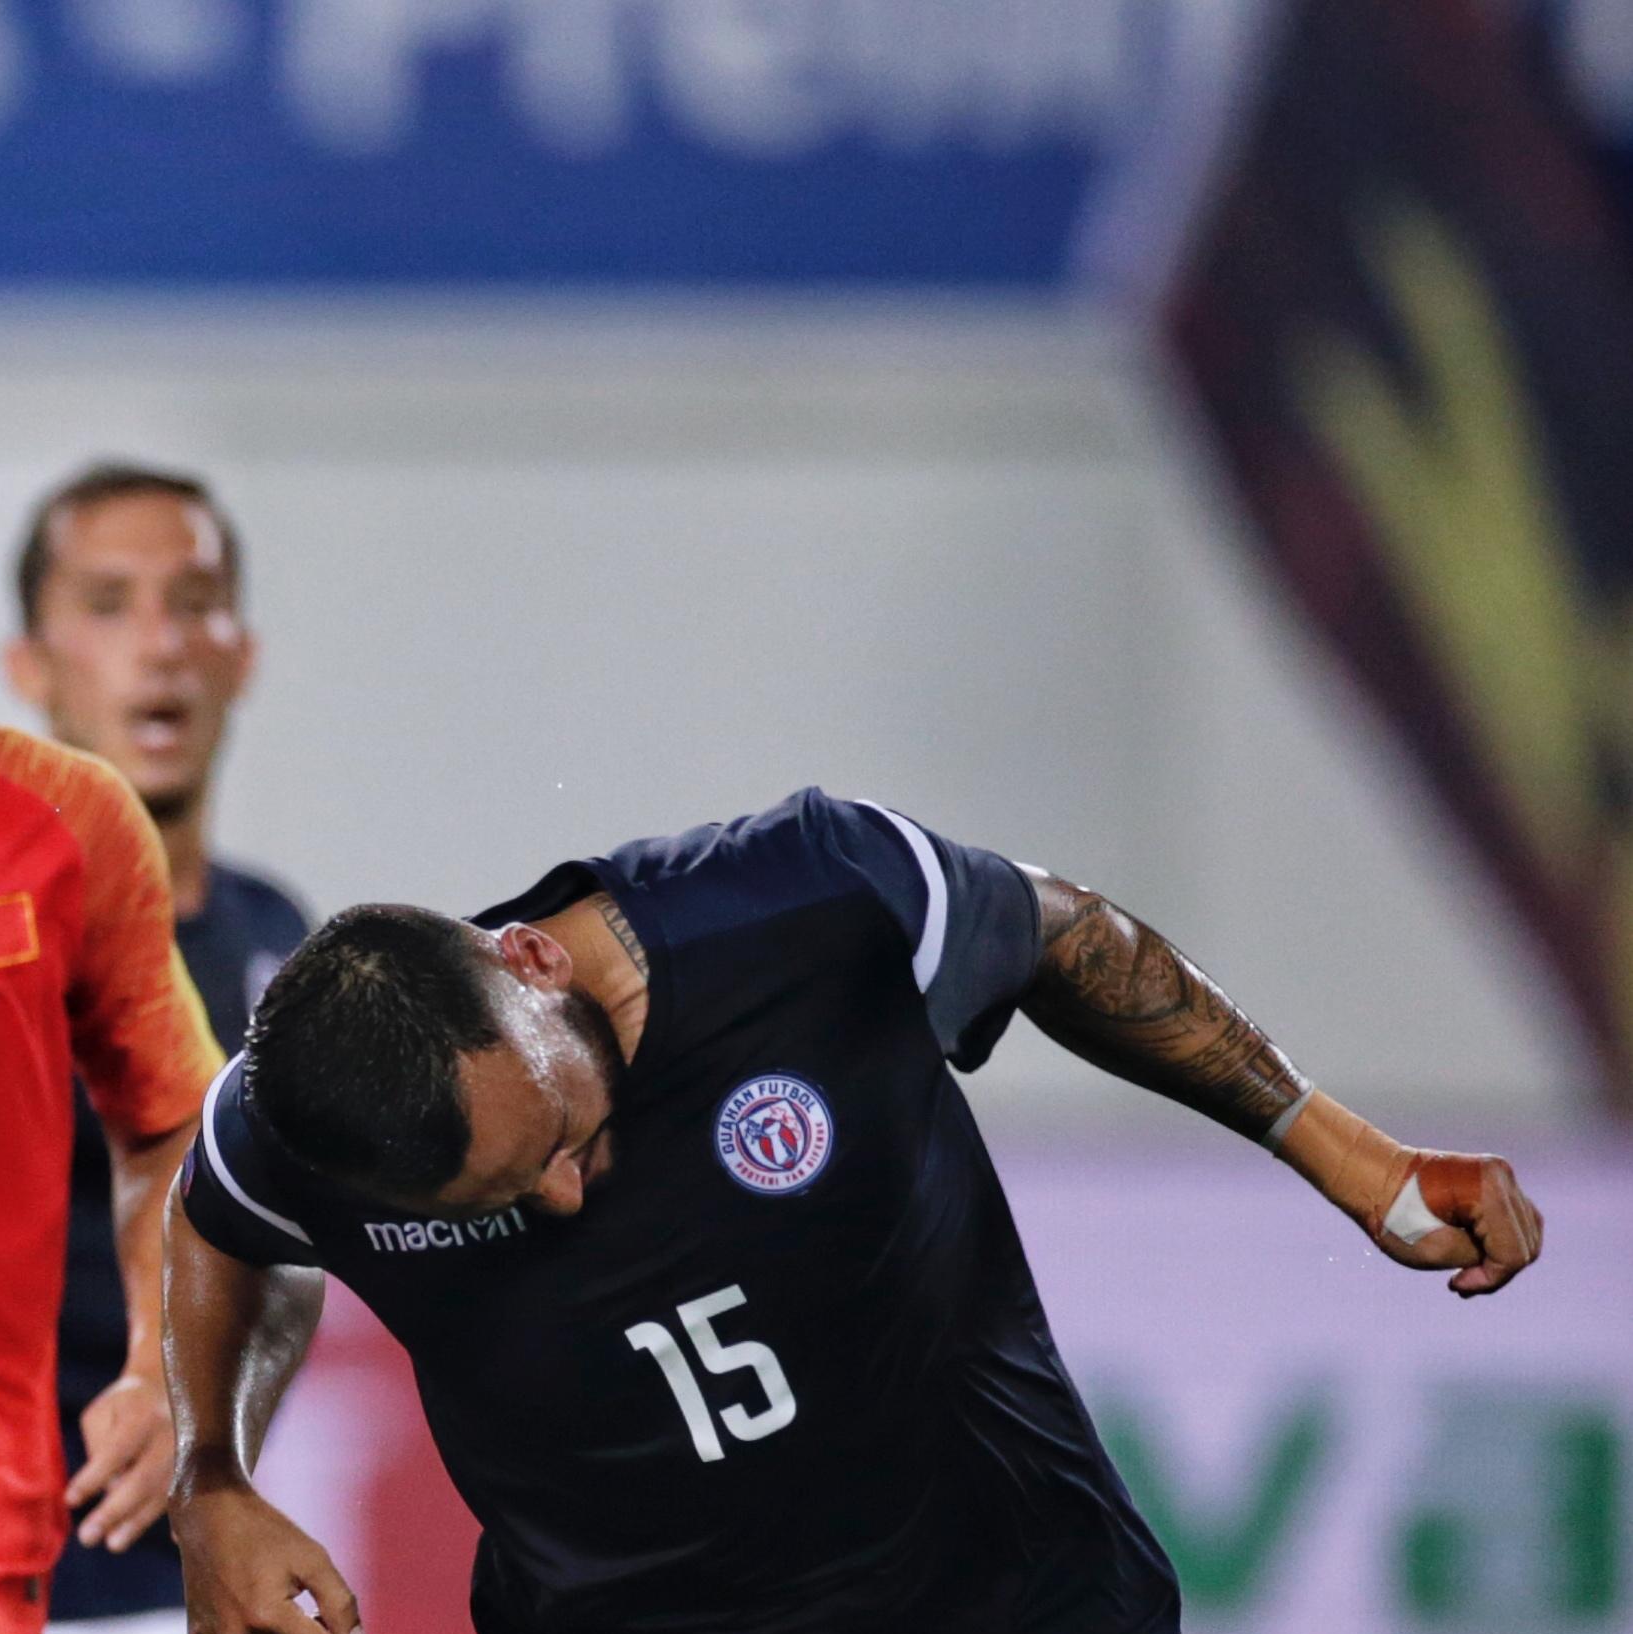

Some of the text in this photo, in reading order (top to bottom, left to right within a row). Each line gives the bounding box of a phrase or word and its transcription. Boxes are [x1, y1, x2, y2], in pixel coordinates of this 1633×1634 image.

[720, 1082, 816, 1155] GUAHAN FUTBOL
[625, 1284, 797, 1462] 15
